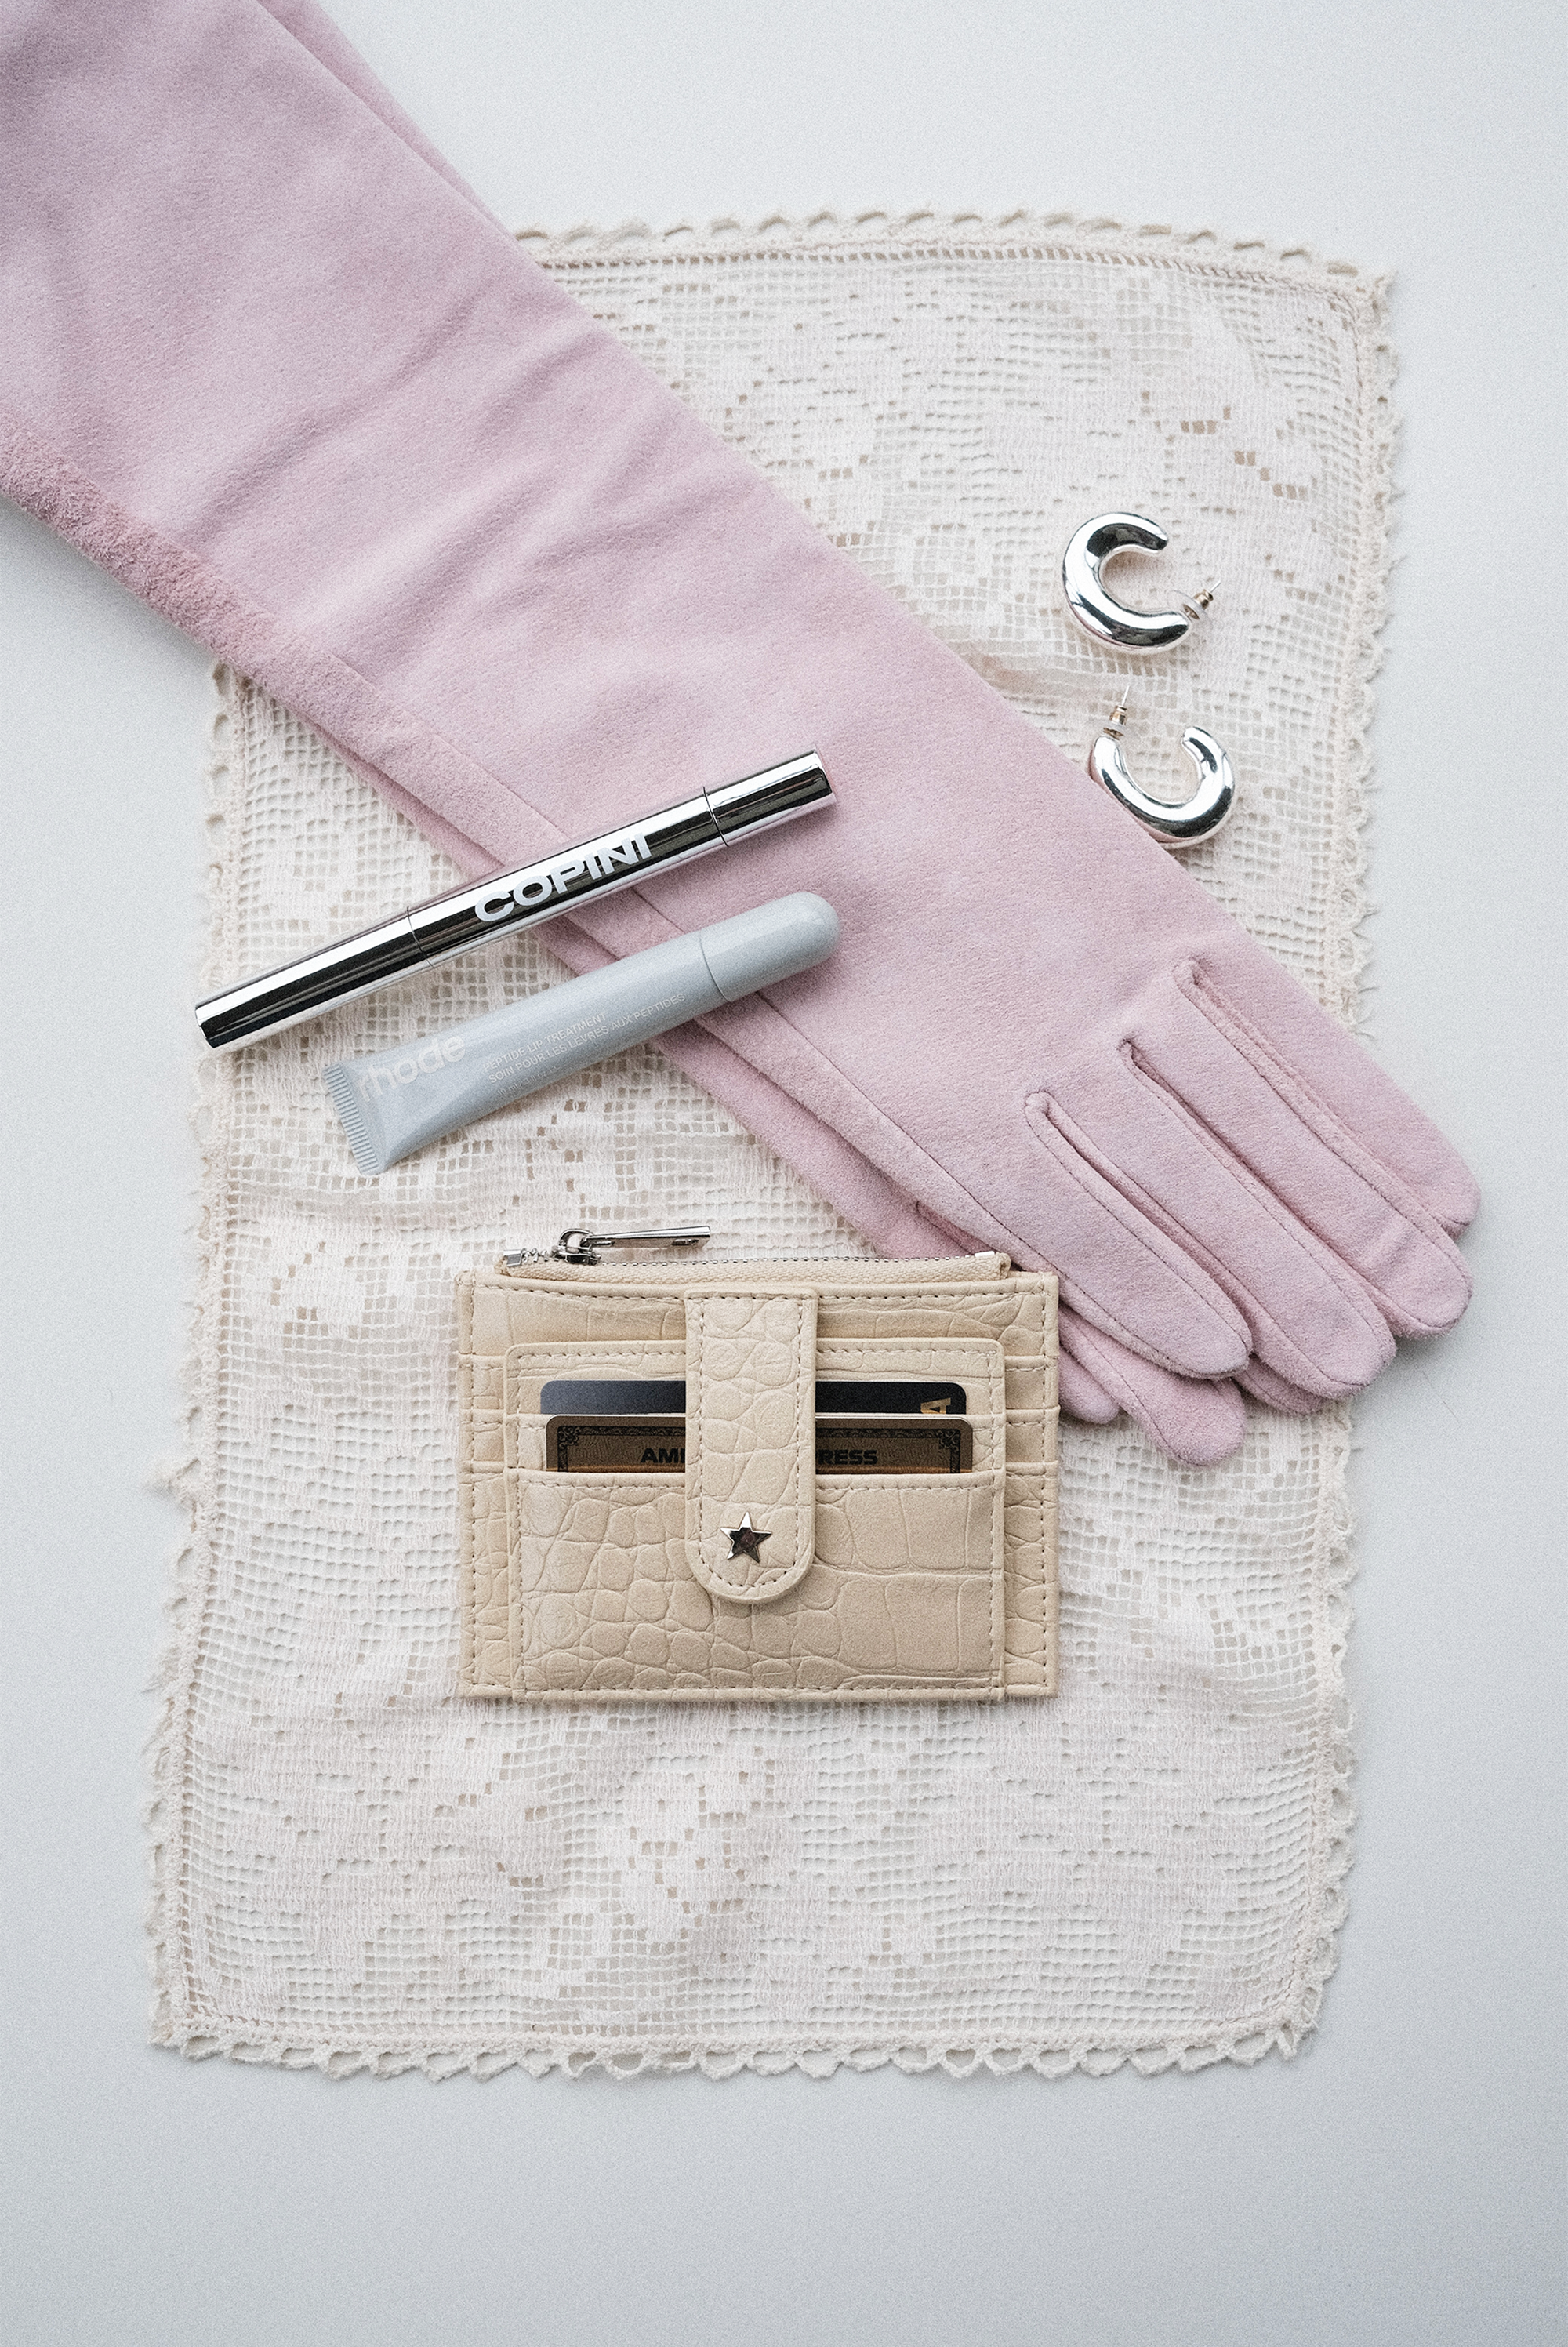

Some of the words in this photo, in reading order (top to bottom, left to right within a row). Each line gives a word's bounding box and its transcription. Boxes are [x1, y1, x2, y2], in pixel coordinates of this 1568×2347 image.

[475, 832, 652, 921] COPINI
[357, 1036, 466, 1103] rhode
[483, 1046, 527, 1072] PEPTIDE
[527, 1039, 543, 1054] LIP
[545, 1012, 607, 1045] TREATMENT
[488, 1066, 515, 1083] SOIN
[515, 1052, 546, 1071] POUR
[546, 1044, 568, 1058] LES
[611, 1015, 633, 1030] AUX
[633, 993, 686, 1020] PEPTIDES
